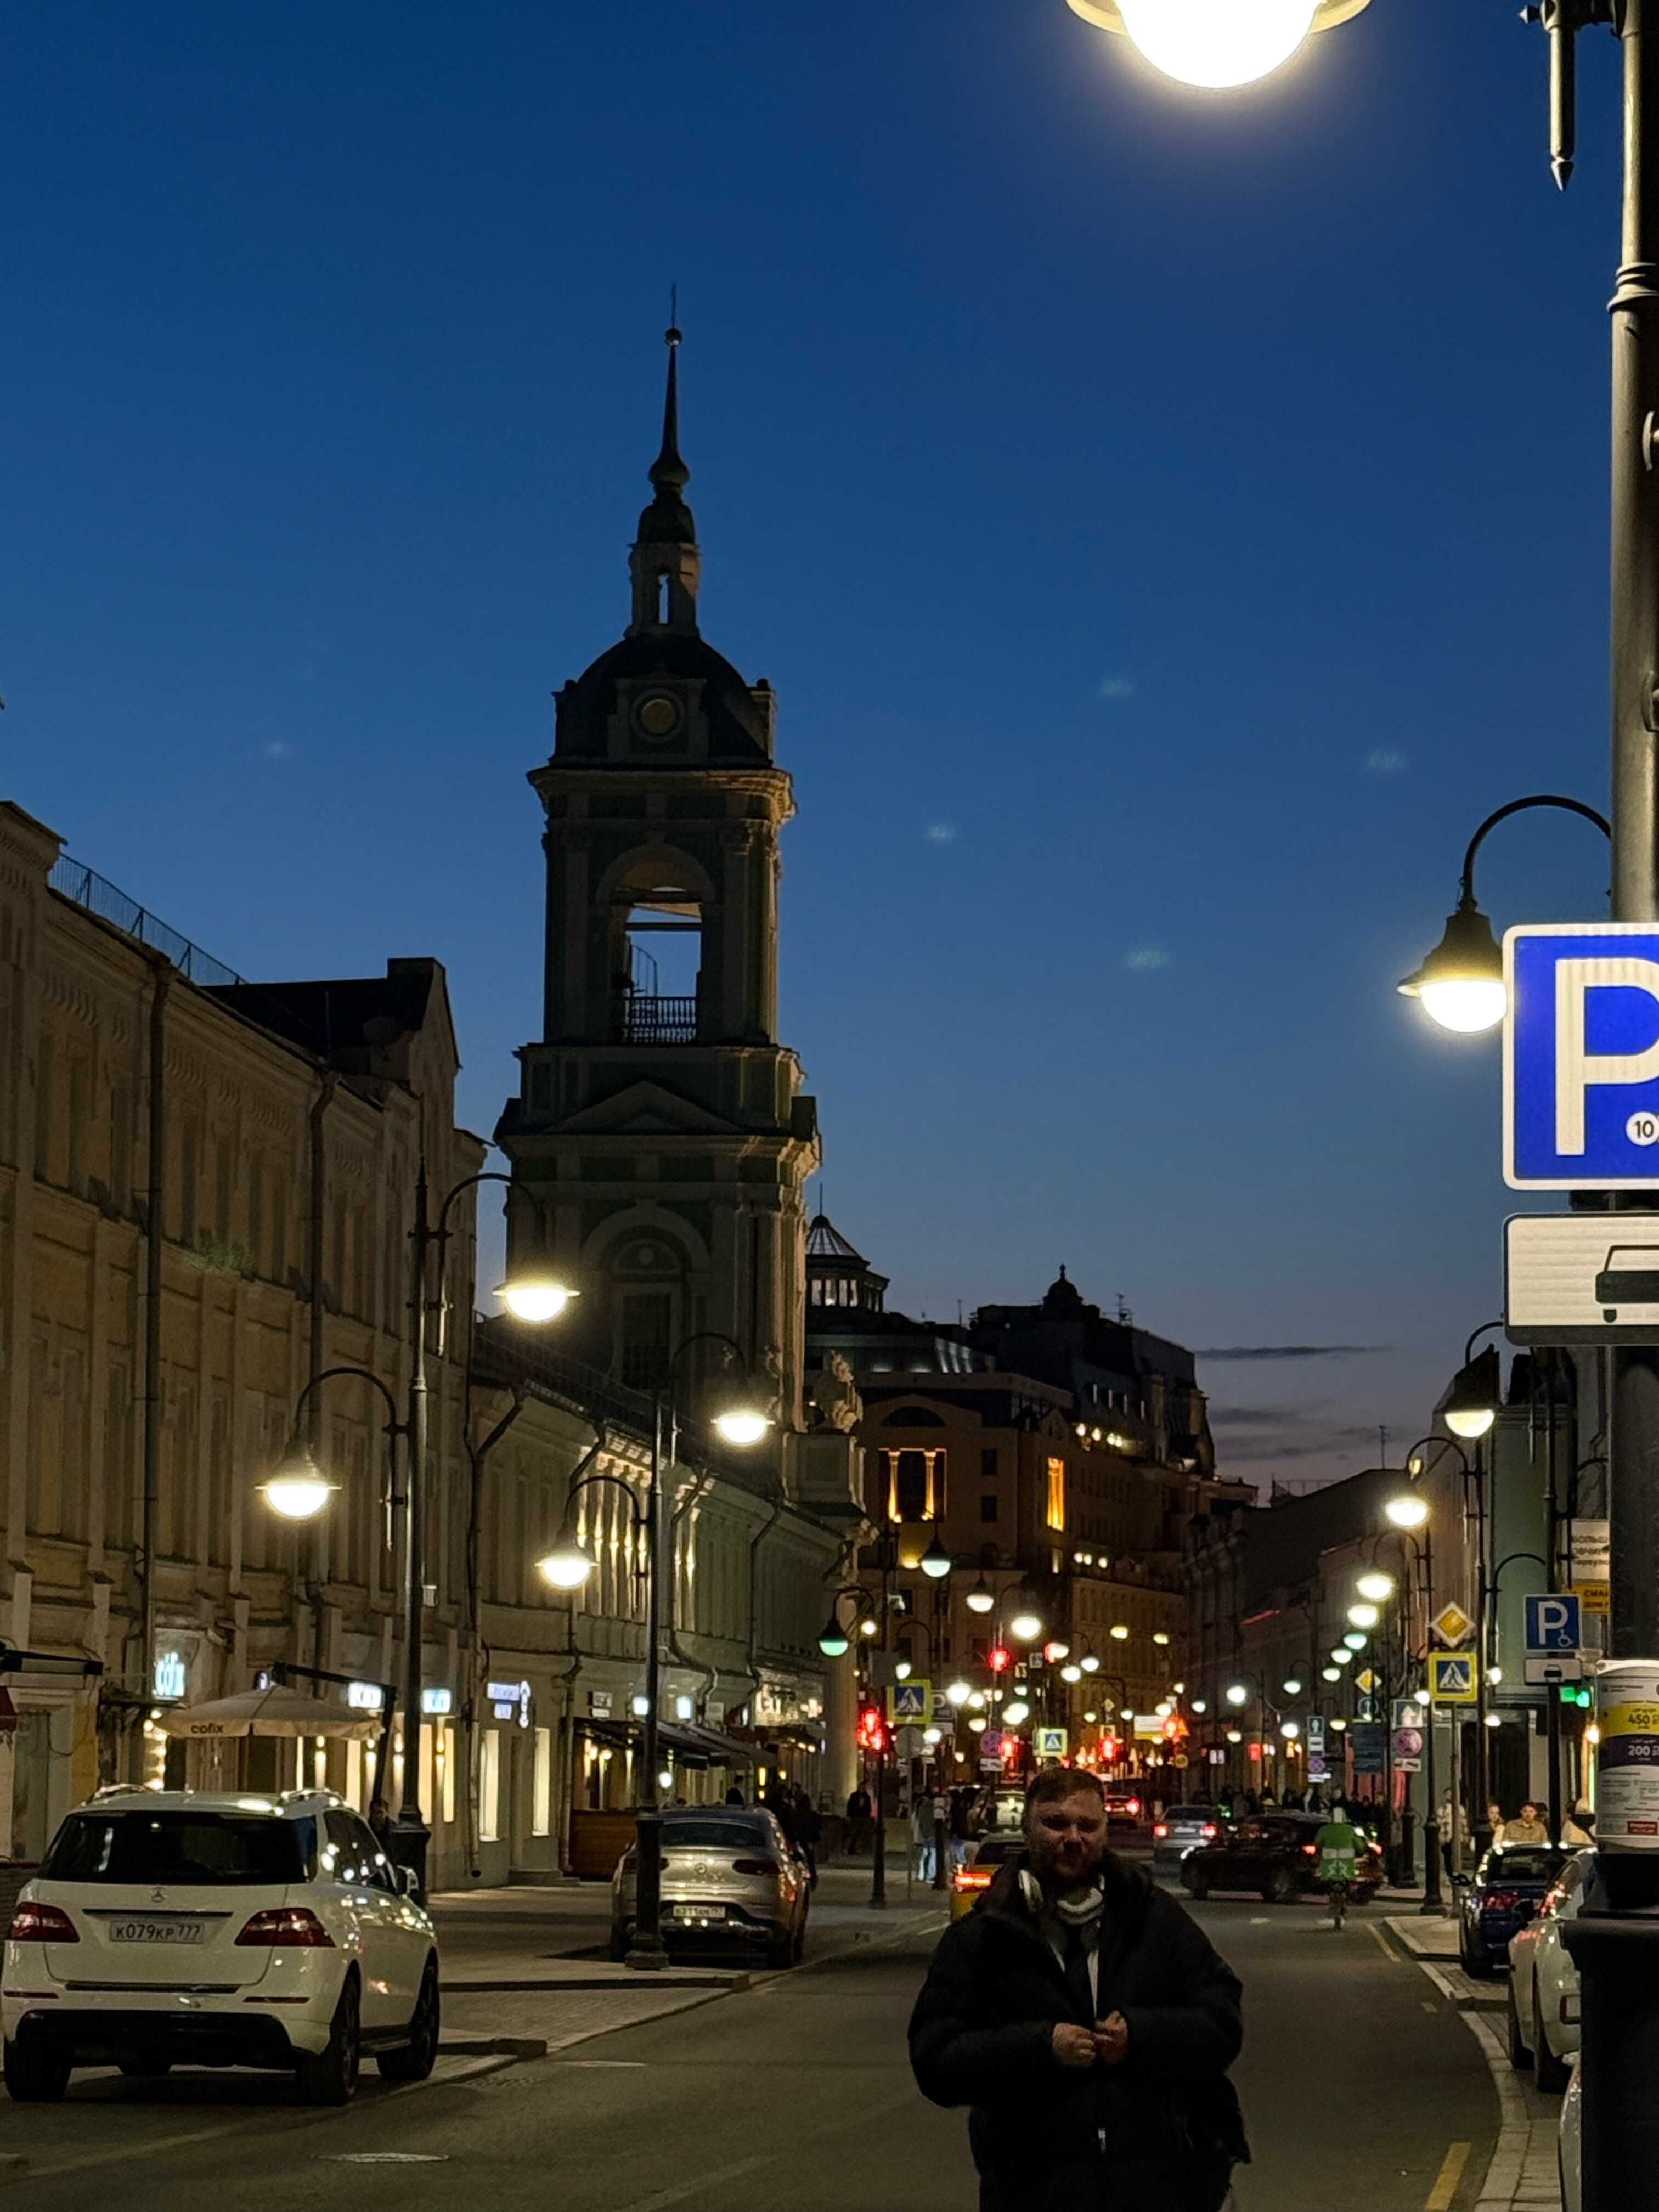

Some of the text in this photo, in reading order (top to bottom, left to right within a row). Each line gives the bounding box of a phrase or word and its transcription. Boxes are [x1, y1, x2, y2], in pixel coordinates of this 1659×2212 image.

[1555, 958, 1659, 1155] P
[1634, 1120, 1654, 1139] 10
[1538, 1601, 1568, 1645] P
[1628, 1713, 1650, 1725] 450
[190, 1723, 224, 1734] cofix
[1628, 1745, 1650, 1756] 200
